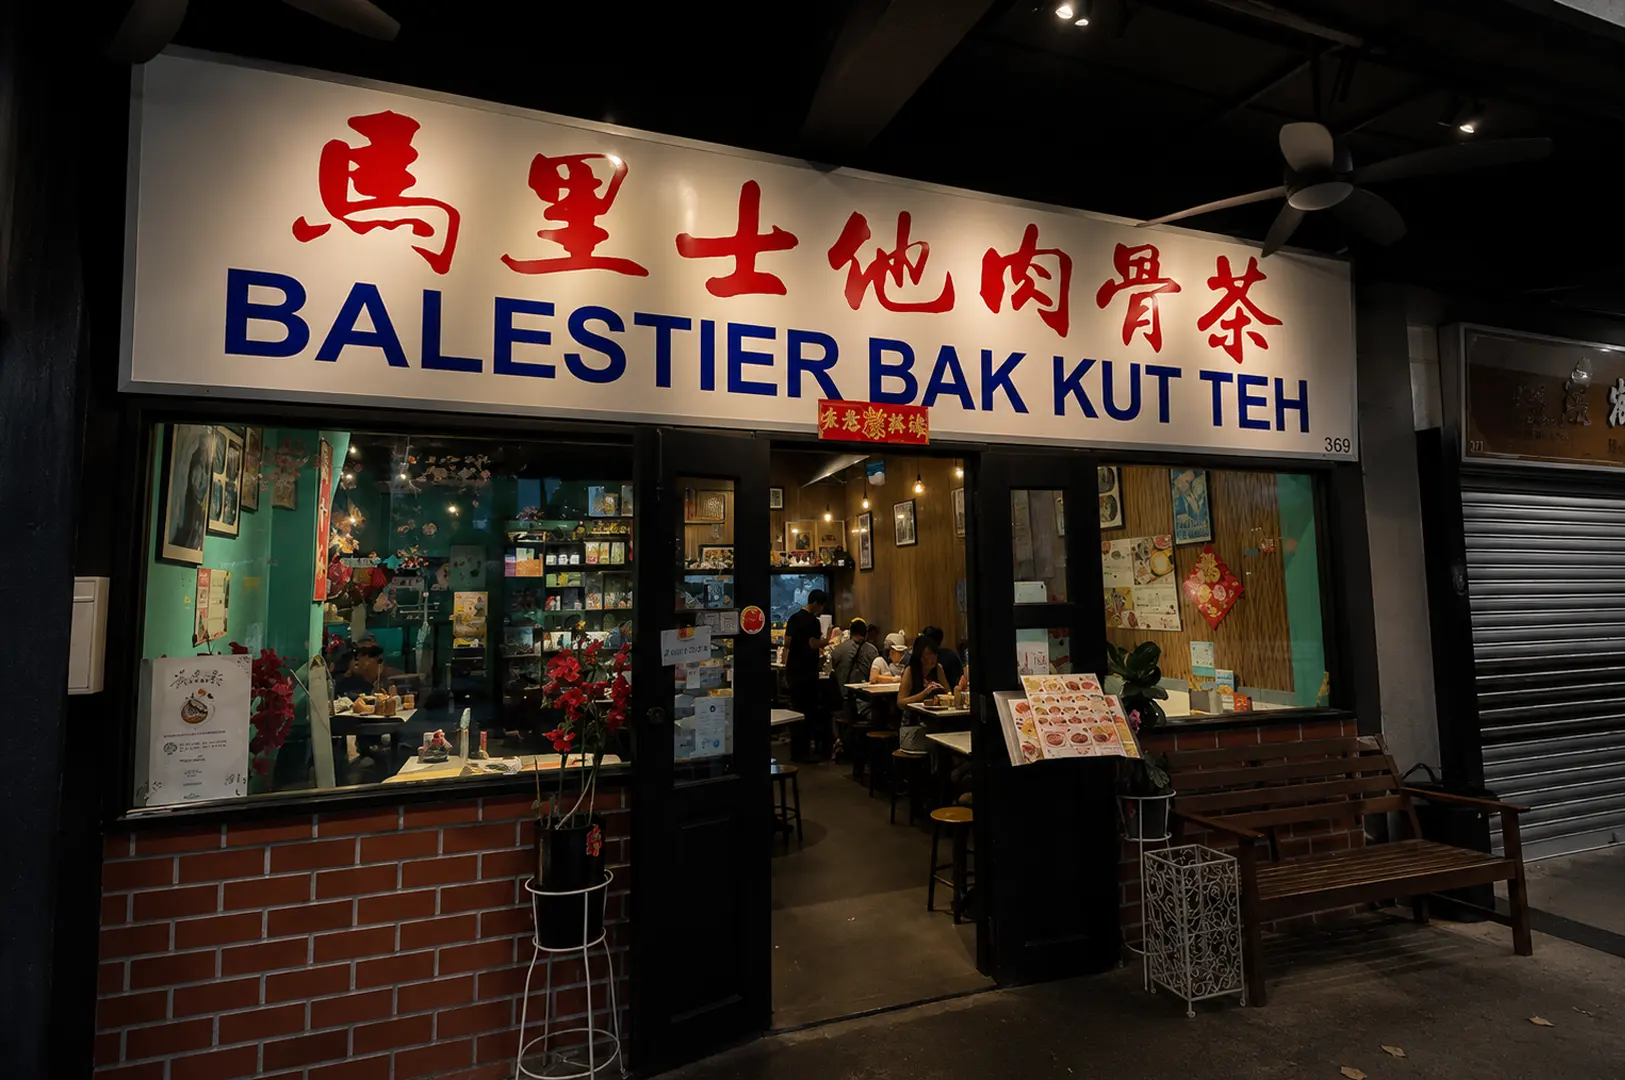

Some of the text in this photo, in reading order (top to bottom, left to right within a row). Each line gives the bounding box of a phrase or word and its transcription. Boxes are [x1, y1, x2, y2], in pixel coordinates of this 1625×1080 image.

[292, 109, 1284, 364] 馬里士他肉骨茶
[224, 267, 1310, 433] BALESTIER BAK KUT TEH
[1324, 436, 1351, 453] 369
